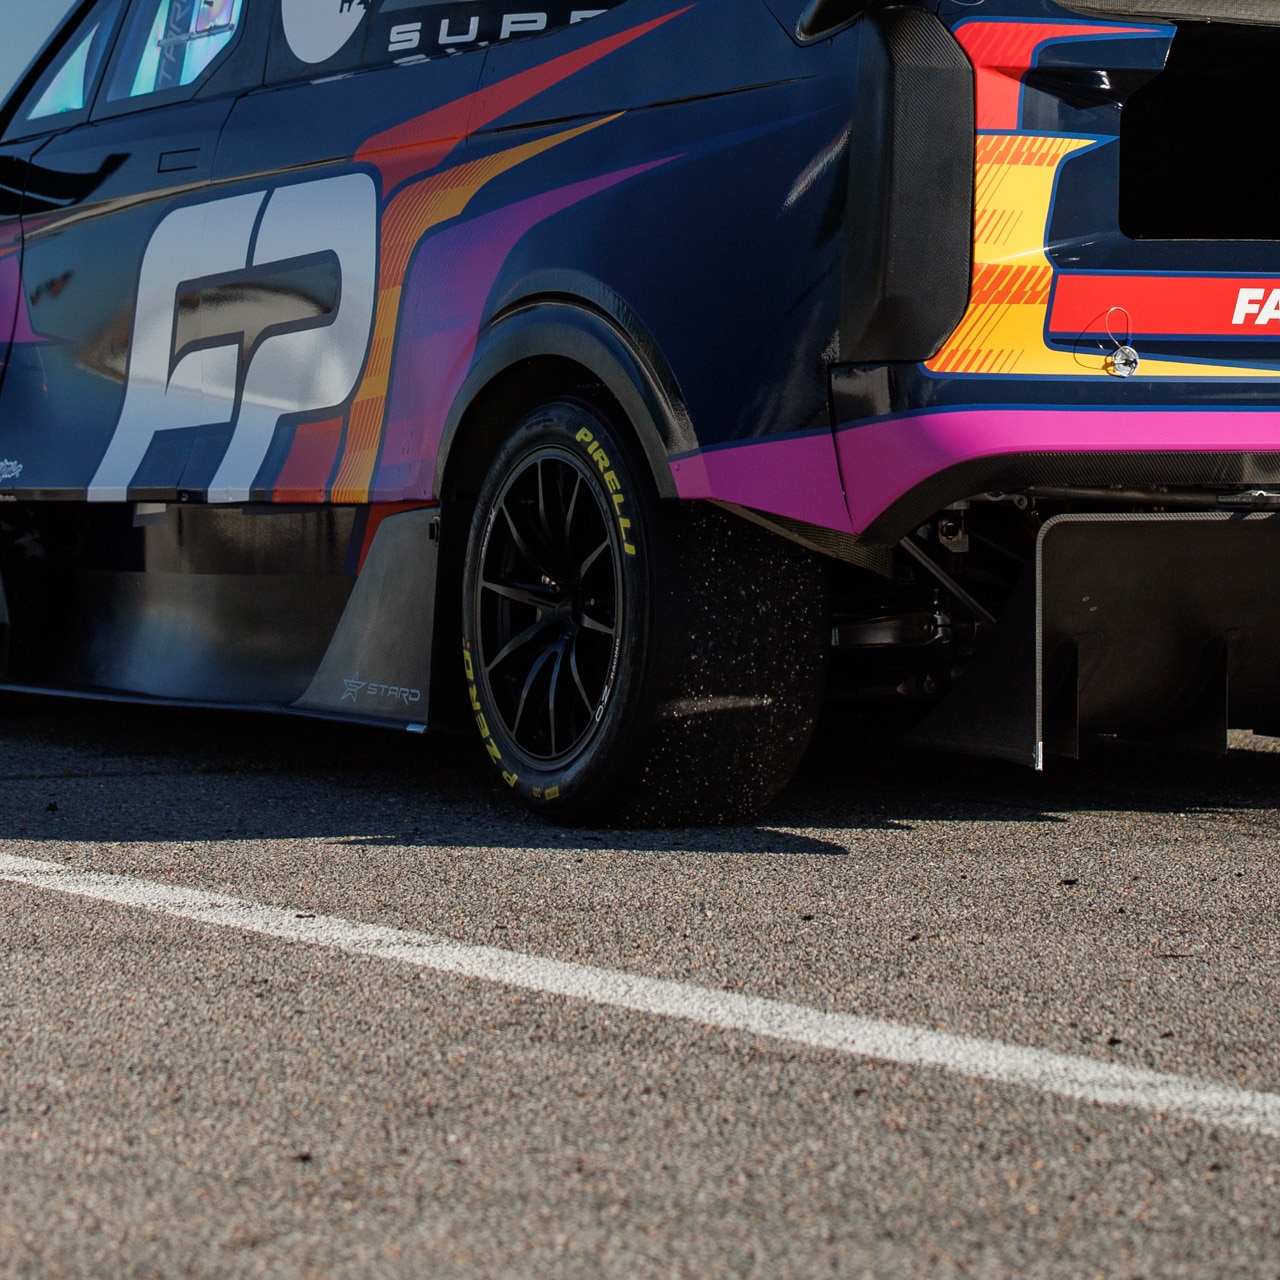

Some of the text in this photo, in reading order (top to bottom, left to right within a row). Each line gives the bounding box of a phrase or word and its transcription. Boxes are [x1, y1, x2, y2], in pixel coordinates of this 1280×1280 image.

[575, 426, 636, 556] PIRELLI
[367, 683, 421, 706] STARD
[462, 648, 519, 789] P ZERO
